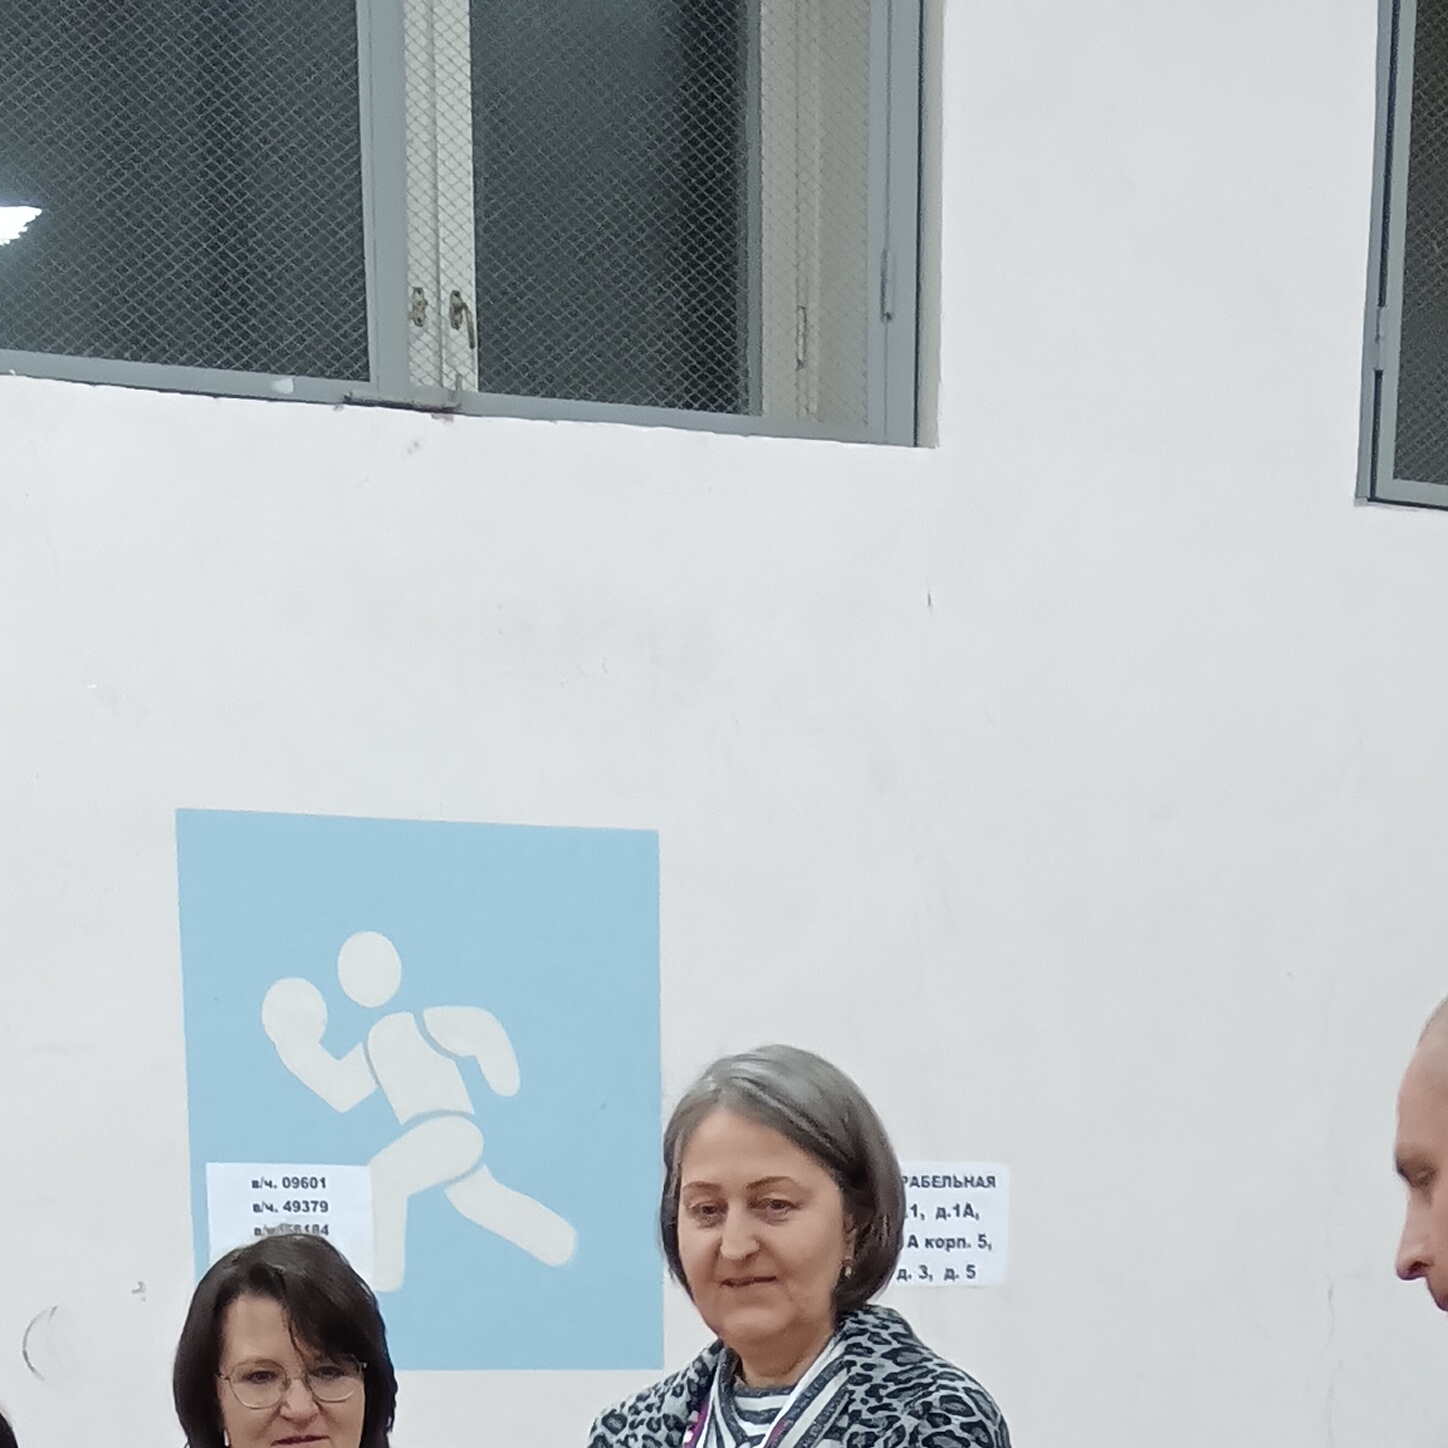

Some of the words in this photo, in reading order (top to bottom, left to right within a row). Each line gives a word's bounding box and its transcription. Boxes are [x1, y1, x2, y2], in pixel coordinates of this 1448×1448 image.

[282, 1176, 327, 1189] 09601
[282, 1200, 329, 1213] 49379
[924, 1237, 972, 1252] корп.
[977, 1233, 992, 1251] 5,
[896, 1268, 912, 1281] д.
[918, 1264, 933, 1282] 3,
[944, 1268, 959, 1281] д.
[966, 1264, 976, 1279] 5
